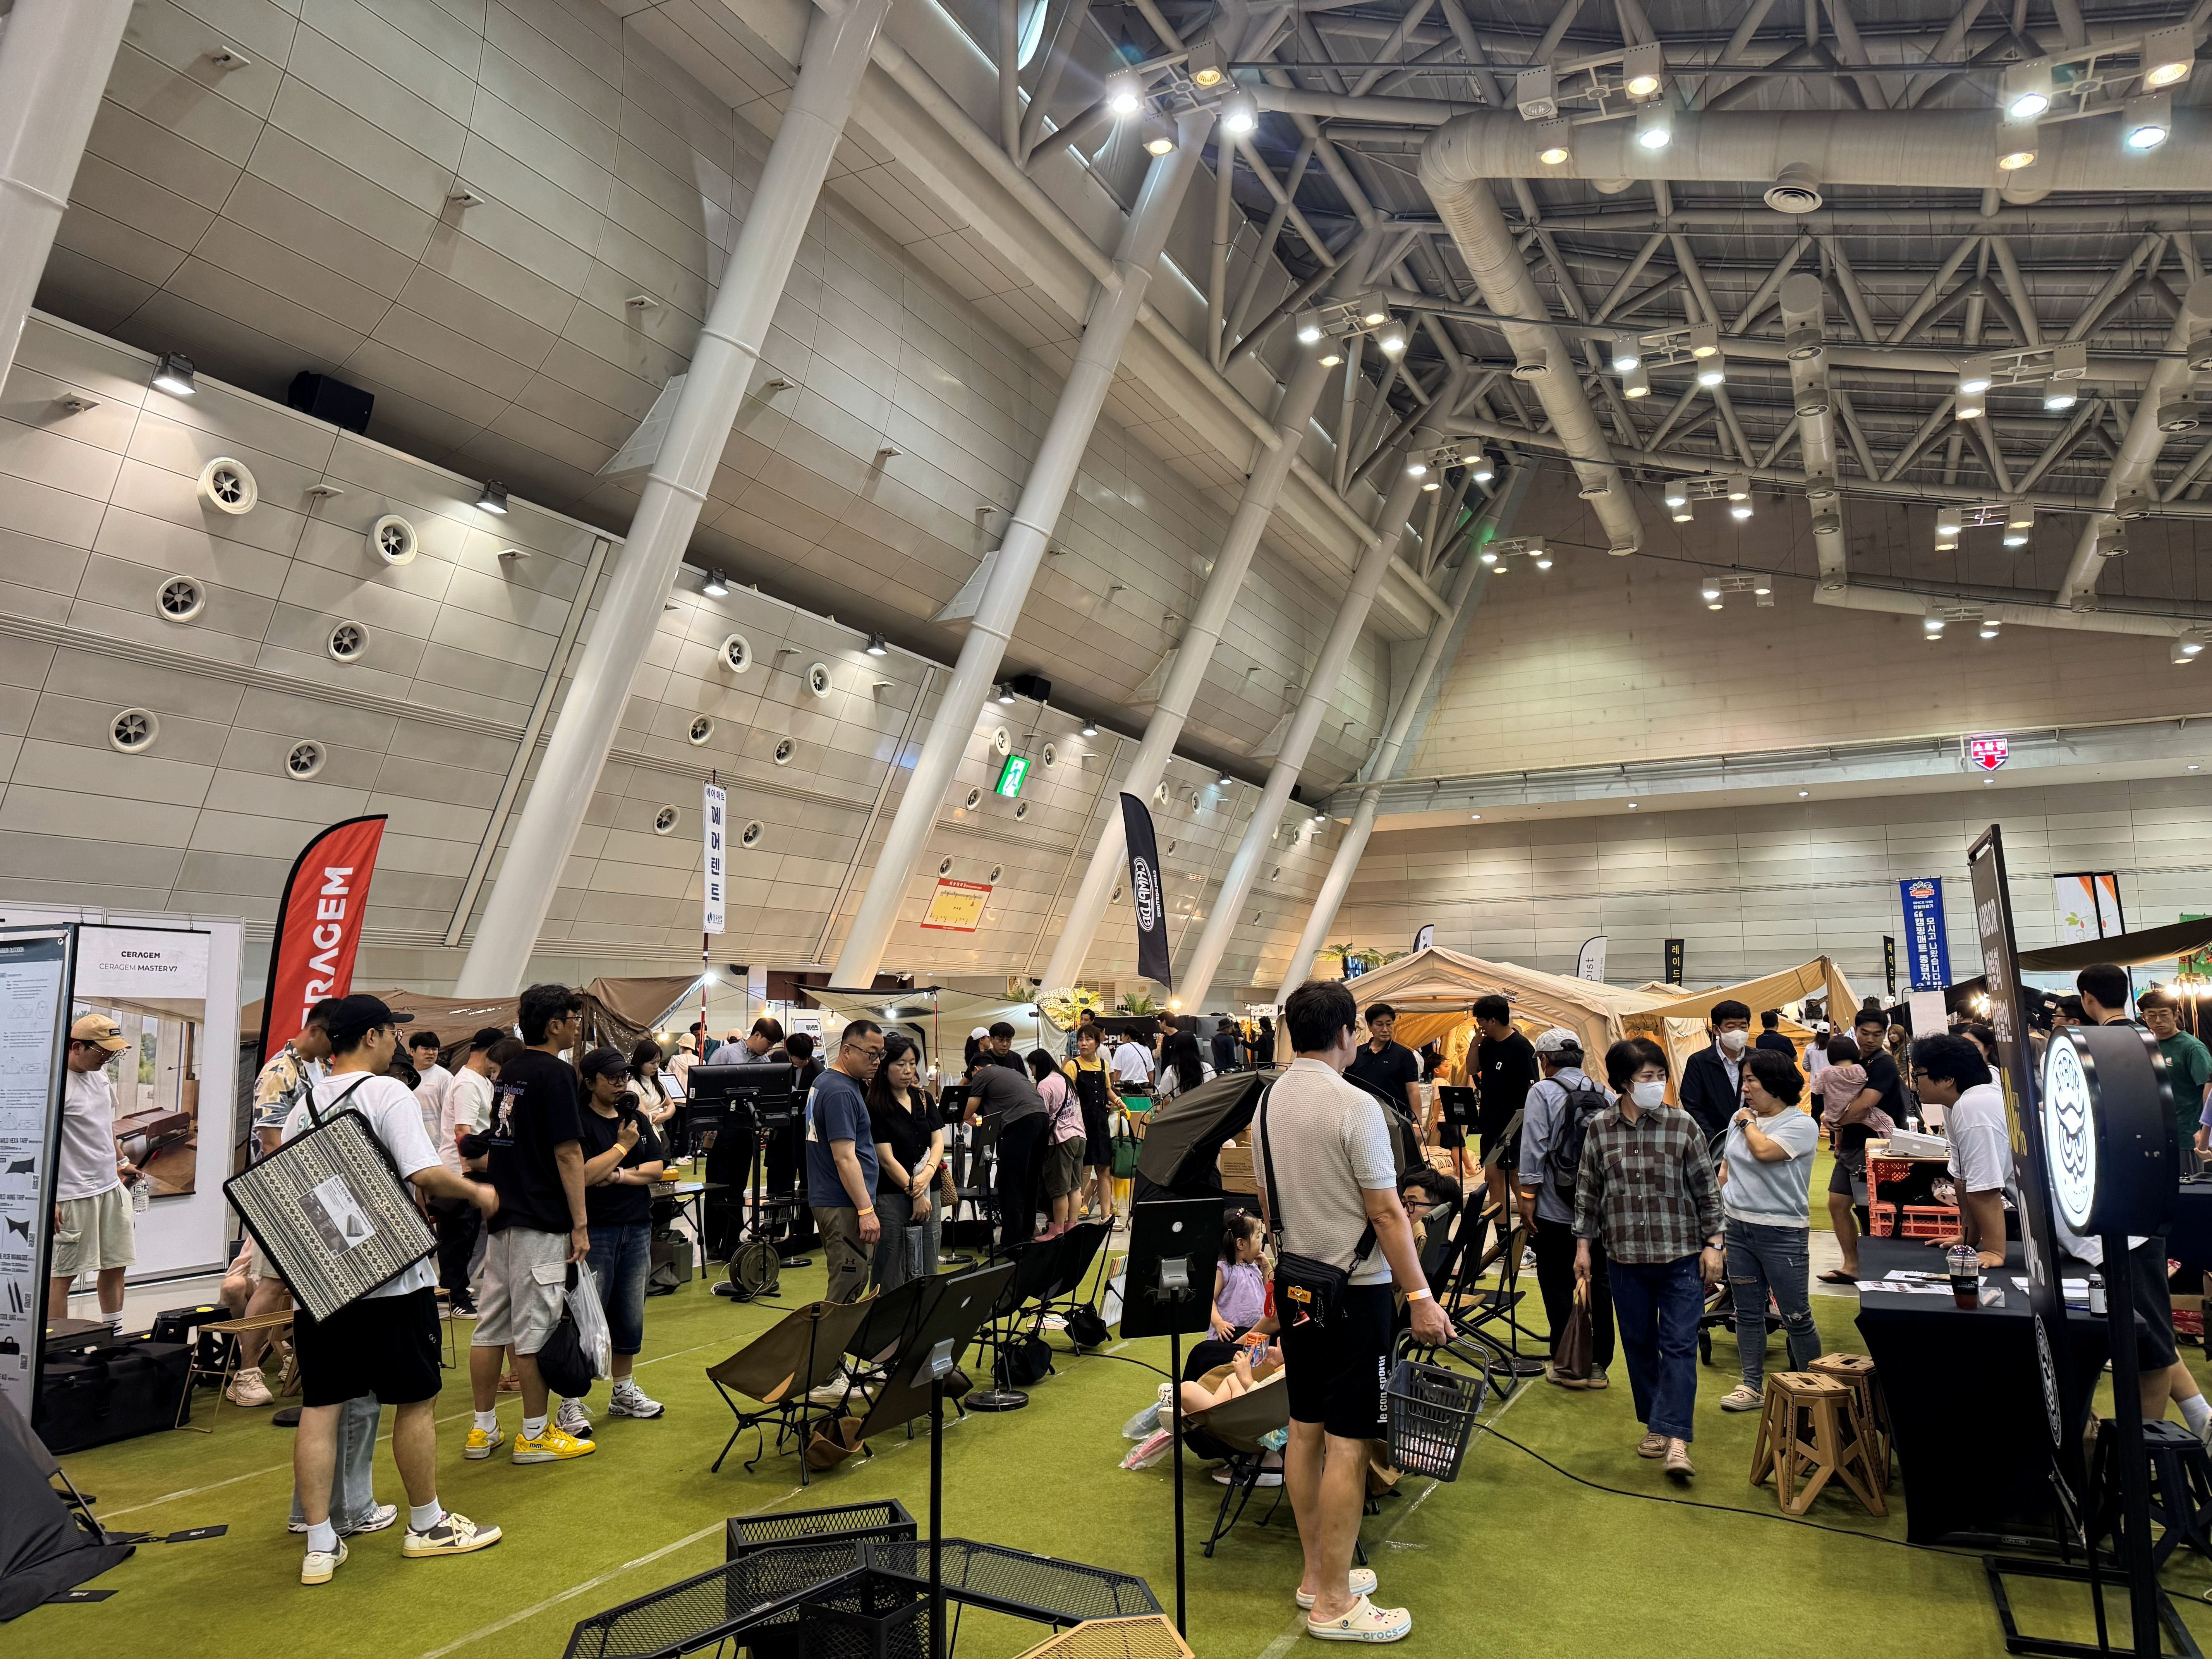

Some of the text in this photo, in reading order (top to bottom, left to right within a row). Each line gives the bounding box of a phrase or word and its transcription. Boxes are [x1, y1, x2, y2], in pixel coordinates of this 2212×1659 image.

[1973, 741, 2005, 751] 소화전
[711, 805, 721, 901] 에어텐트
[1926, 917, 1937, 940] 모시고
[1978, 898, 1999, 938] ARBOR
[1378, 1355, 1388, 1390] sportif
[1377, 1413, 1388, 1423] le
[1363, 1628, 1398, 1640] crocs
